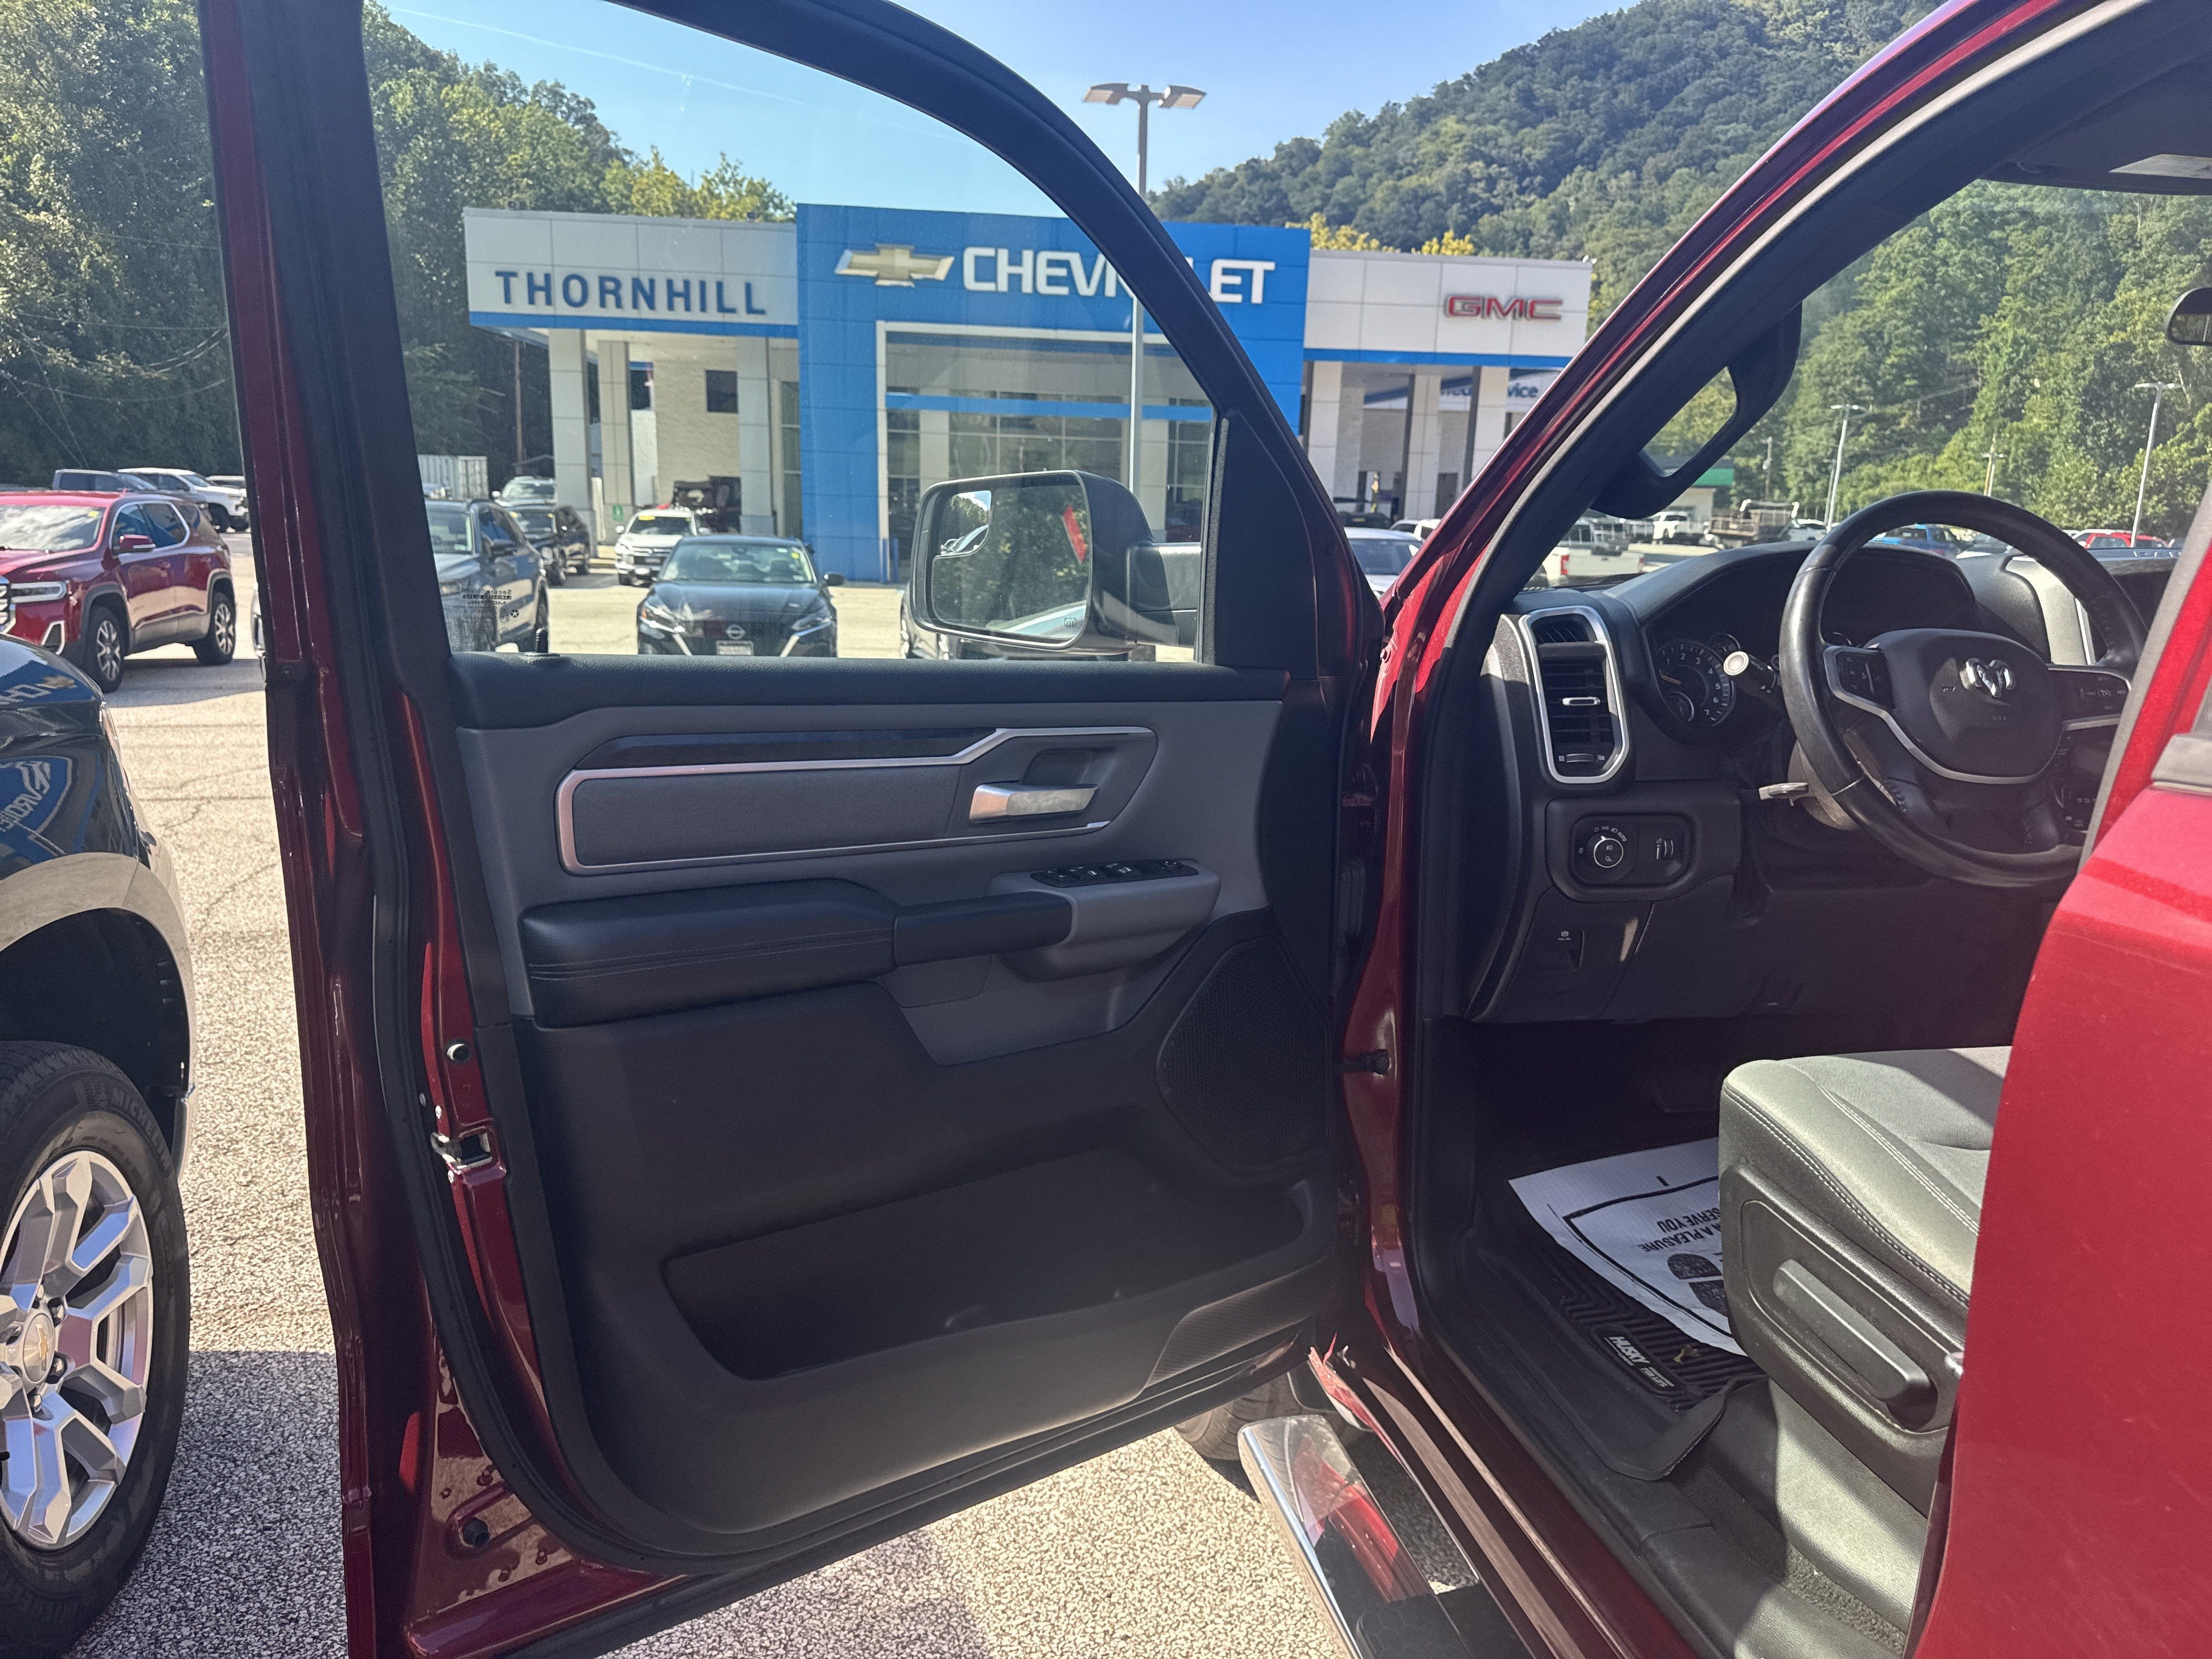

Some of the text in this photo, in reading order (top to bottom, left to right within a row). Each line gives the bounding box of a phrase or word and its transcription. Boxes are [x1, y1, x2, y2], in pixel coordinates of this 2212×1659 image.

[963, 246, 1276, 304] CHEVET
[495, 270, 767, 315] THORNHILL
[1444, 294, 1563, 321] GMC
[1617, 832, 1627, 842] AUTO
[111, 1086, 172, 1170] MICHELIN
[1656, 1207, 1721, 1233] SERVE YOU
[1700, 1226, 1714, 1235] A
[1637, 1228, 1705, 1252] PLEASURE
[1608, 1336, 1651, 1364] HUSKY
